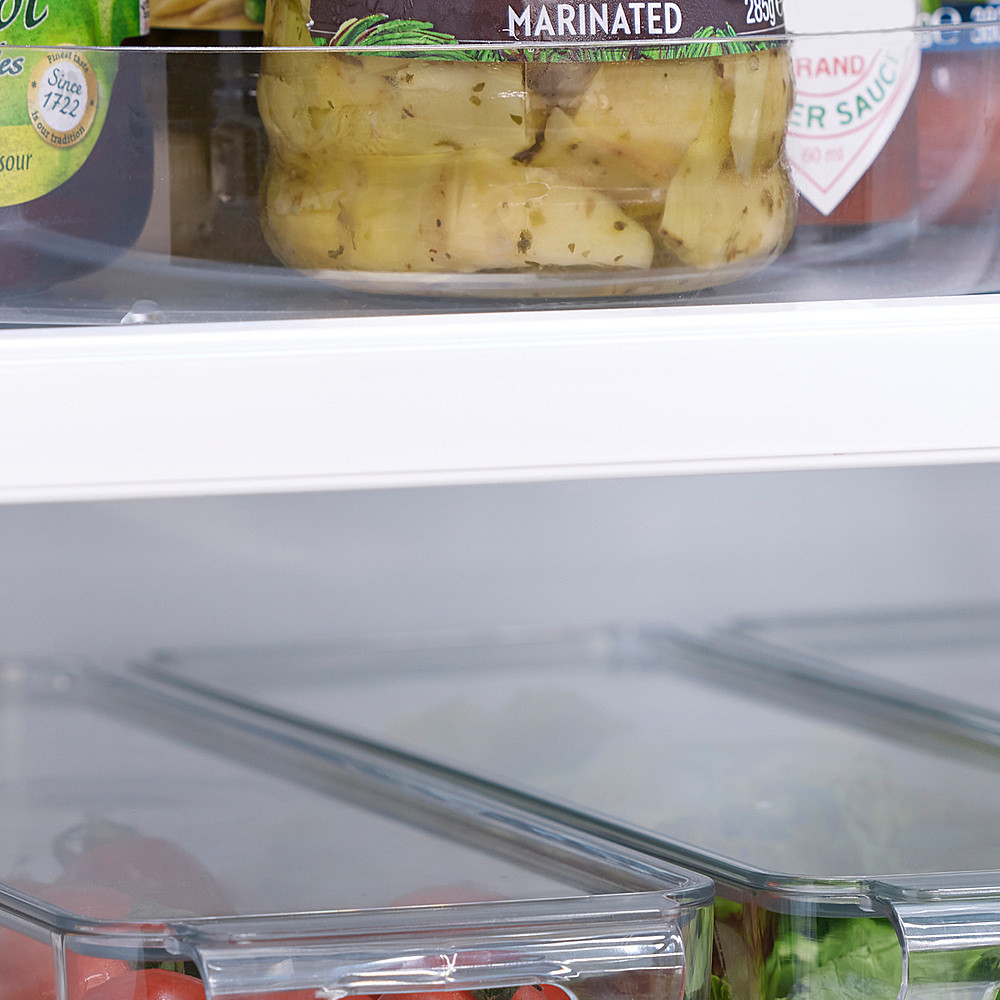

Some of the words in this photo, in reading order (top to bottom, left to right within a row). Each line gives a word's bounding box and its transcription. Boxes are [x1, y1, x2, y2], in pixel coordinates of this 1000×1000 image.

[507, 3, 683, 37] MARINATED
[745, 0, 776, 27] 285g
[796, 55, 865, 77] RAND
[47, 68, 82, 95] Since
[43, 91, 80, 118] 1722
[36, 122, 50, 139] our
[50, 125, 86, 145] tradition
